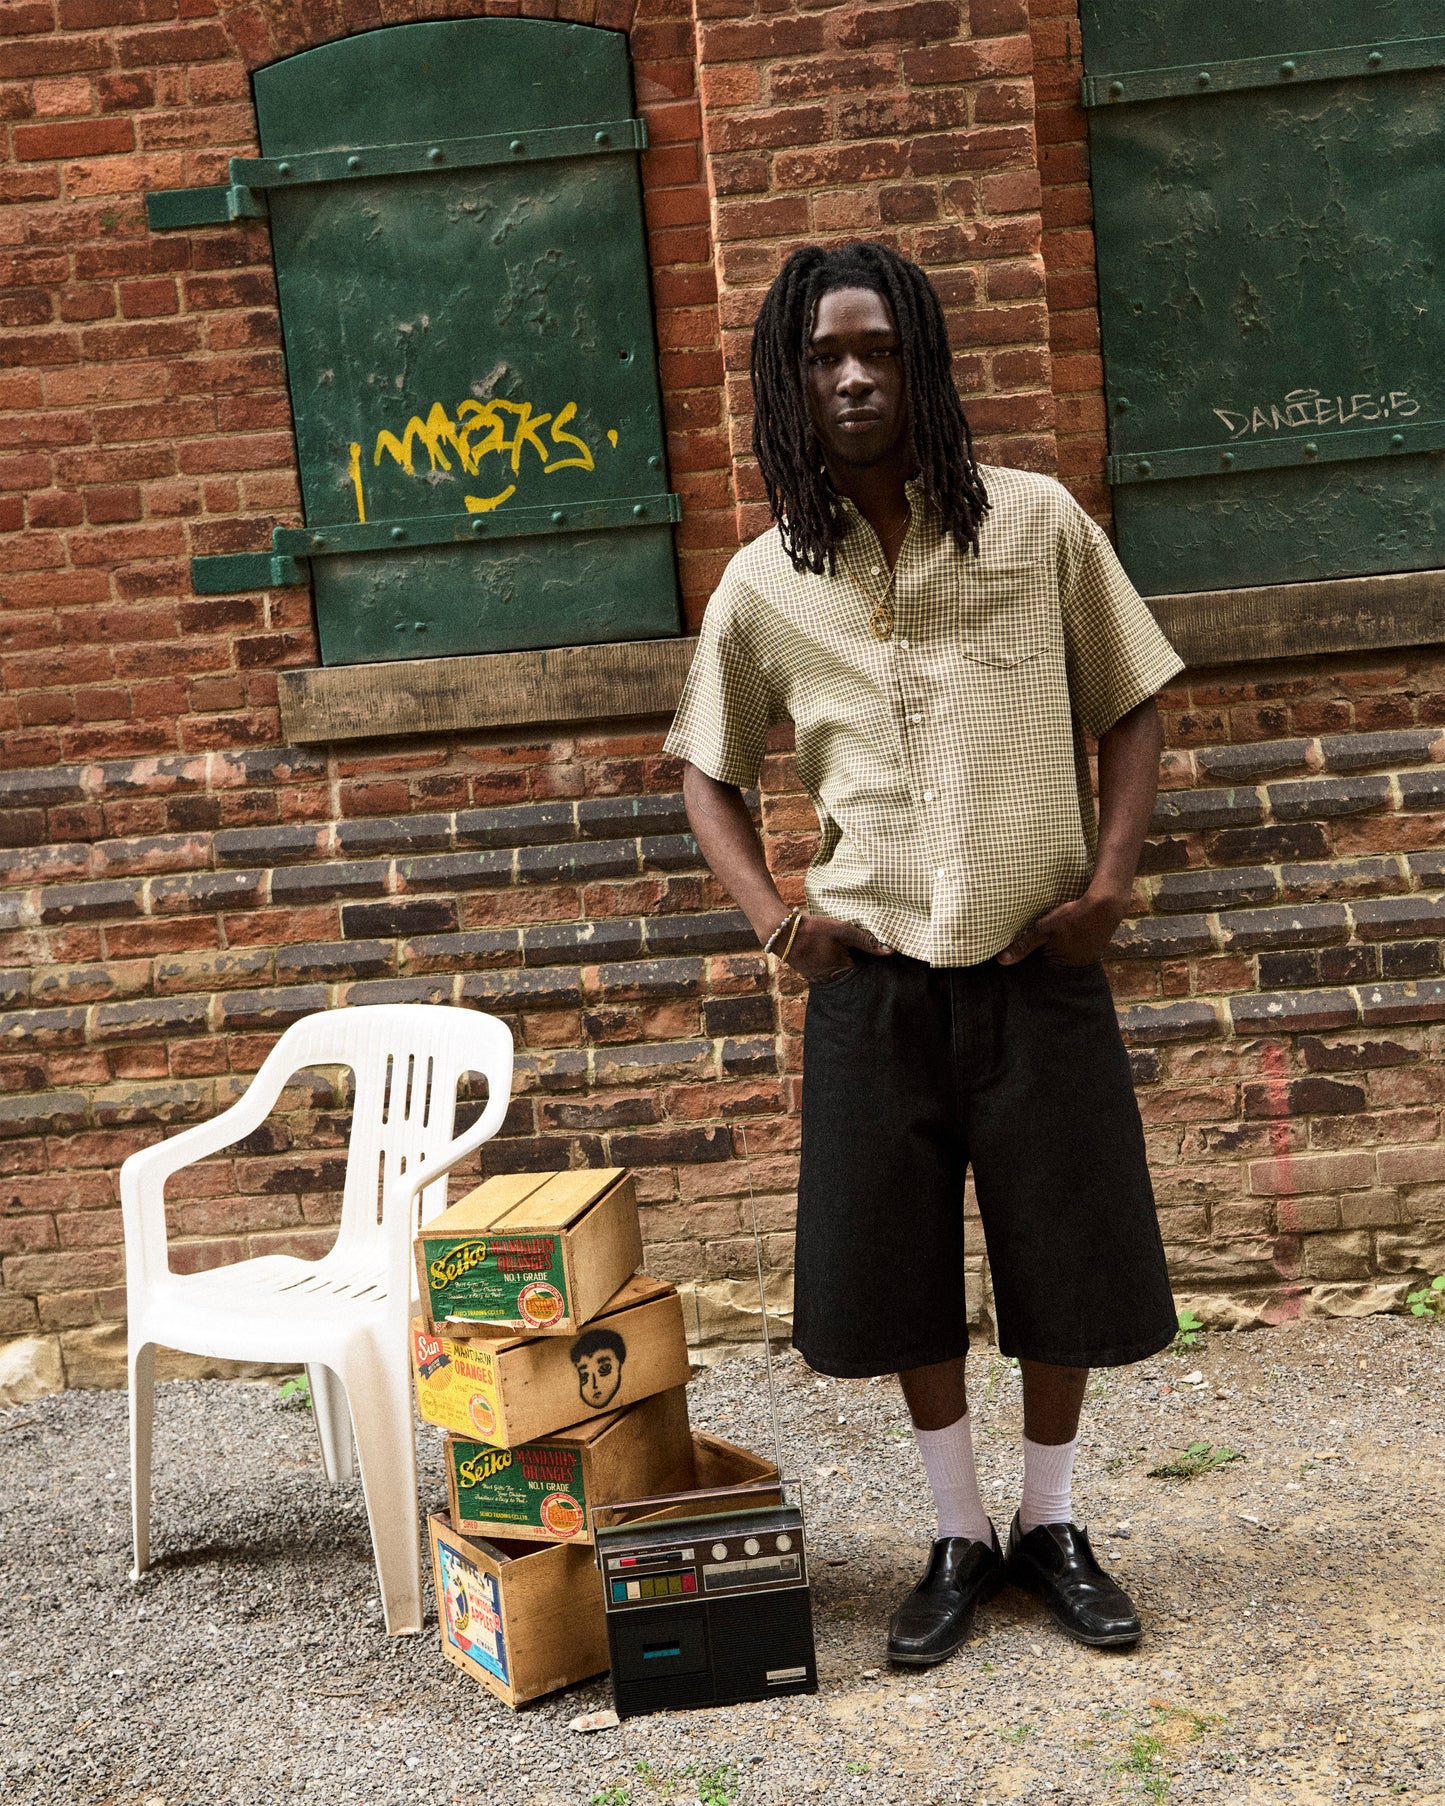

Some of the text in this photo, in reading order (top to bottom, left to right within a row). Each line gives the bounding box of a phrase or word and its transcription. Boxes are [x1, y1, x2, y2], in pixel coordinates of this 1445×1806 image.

[489, 1238, 555, 1256] MANDARIN
[430, 1240, 487, 1290] Seiko
[497, 1253, 553, 1272] ORANGES
[523, 1272, 548, 1281] GRADE
[418, 1336, 440, 1360] Sun
[453, 1345, 492, 1365] MANDARIN
[454, 1359, 493, 1385] ORANGES
[515, 1449, 576, 1466] MANDARIN
[460, 1448, 512, 1488] Seiko
[522, 1465, 574, 1482] ORANGES
[546, 1483, 570, 1492] GRADE
[463, 1519, 478, 1529] SHED
[471, 1606, 494, 1634] APPLES
